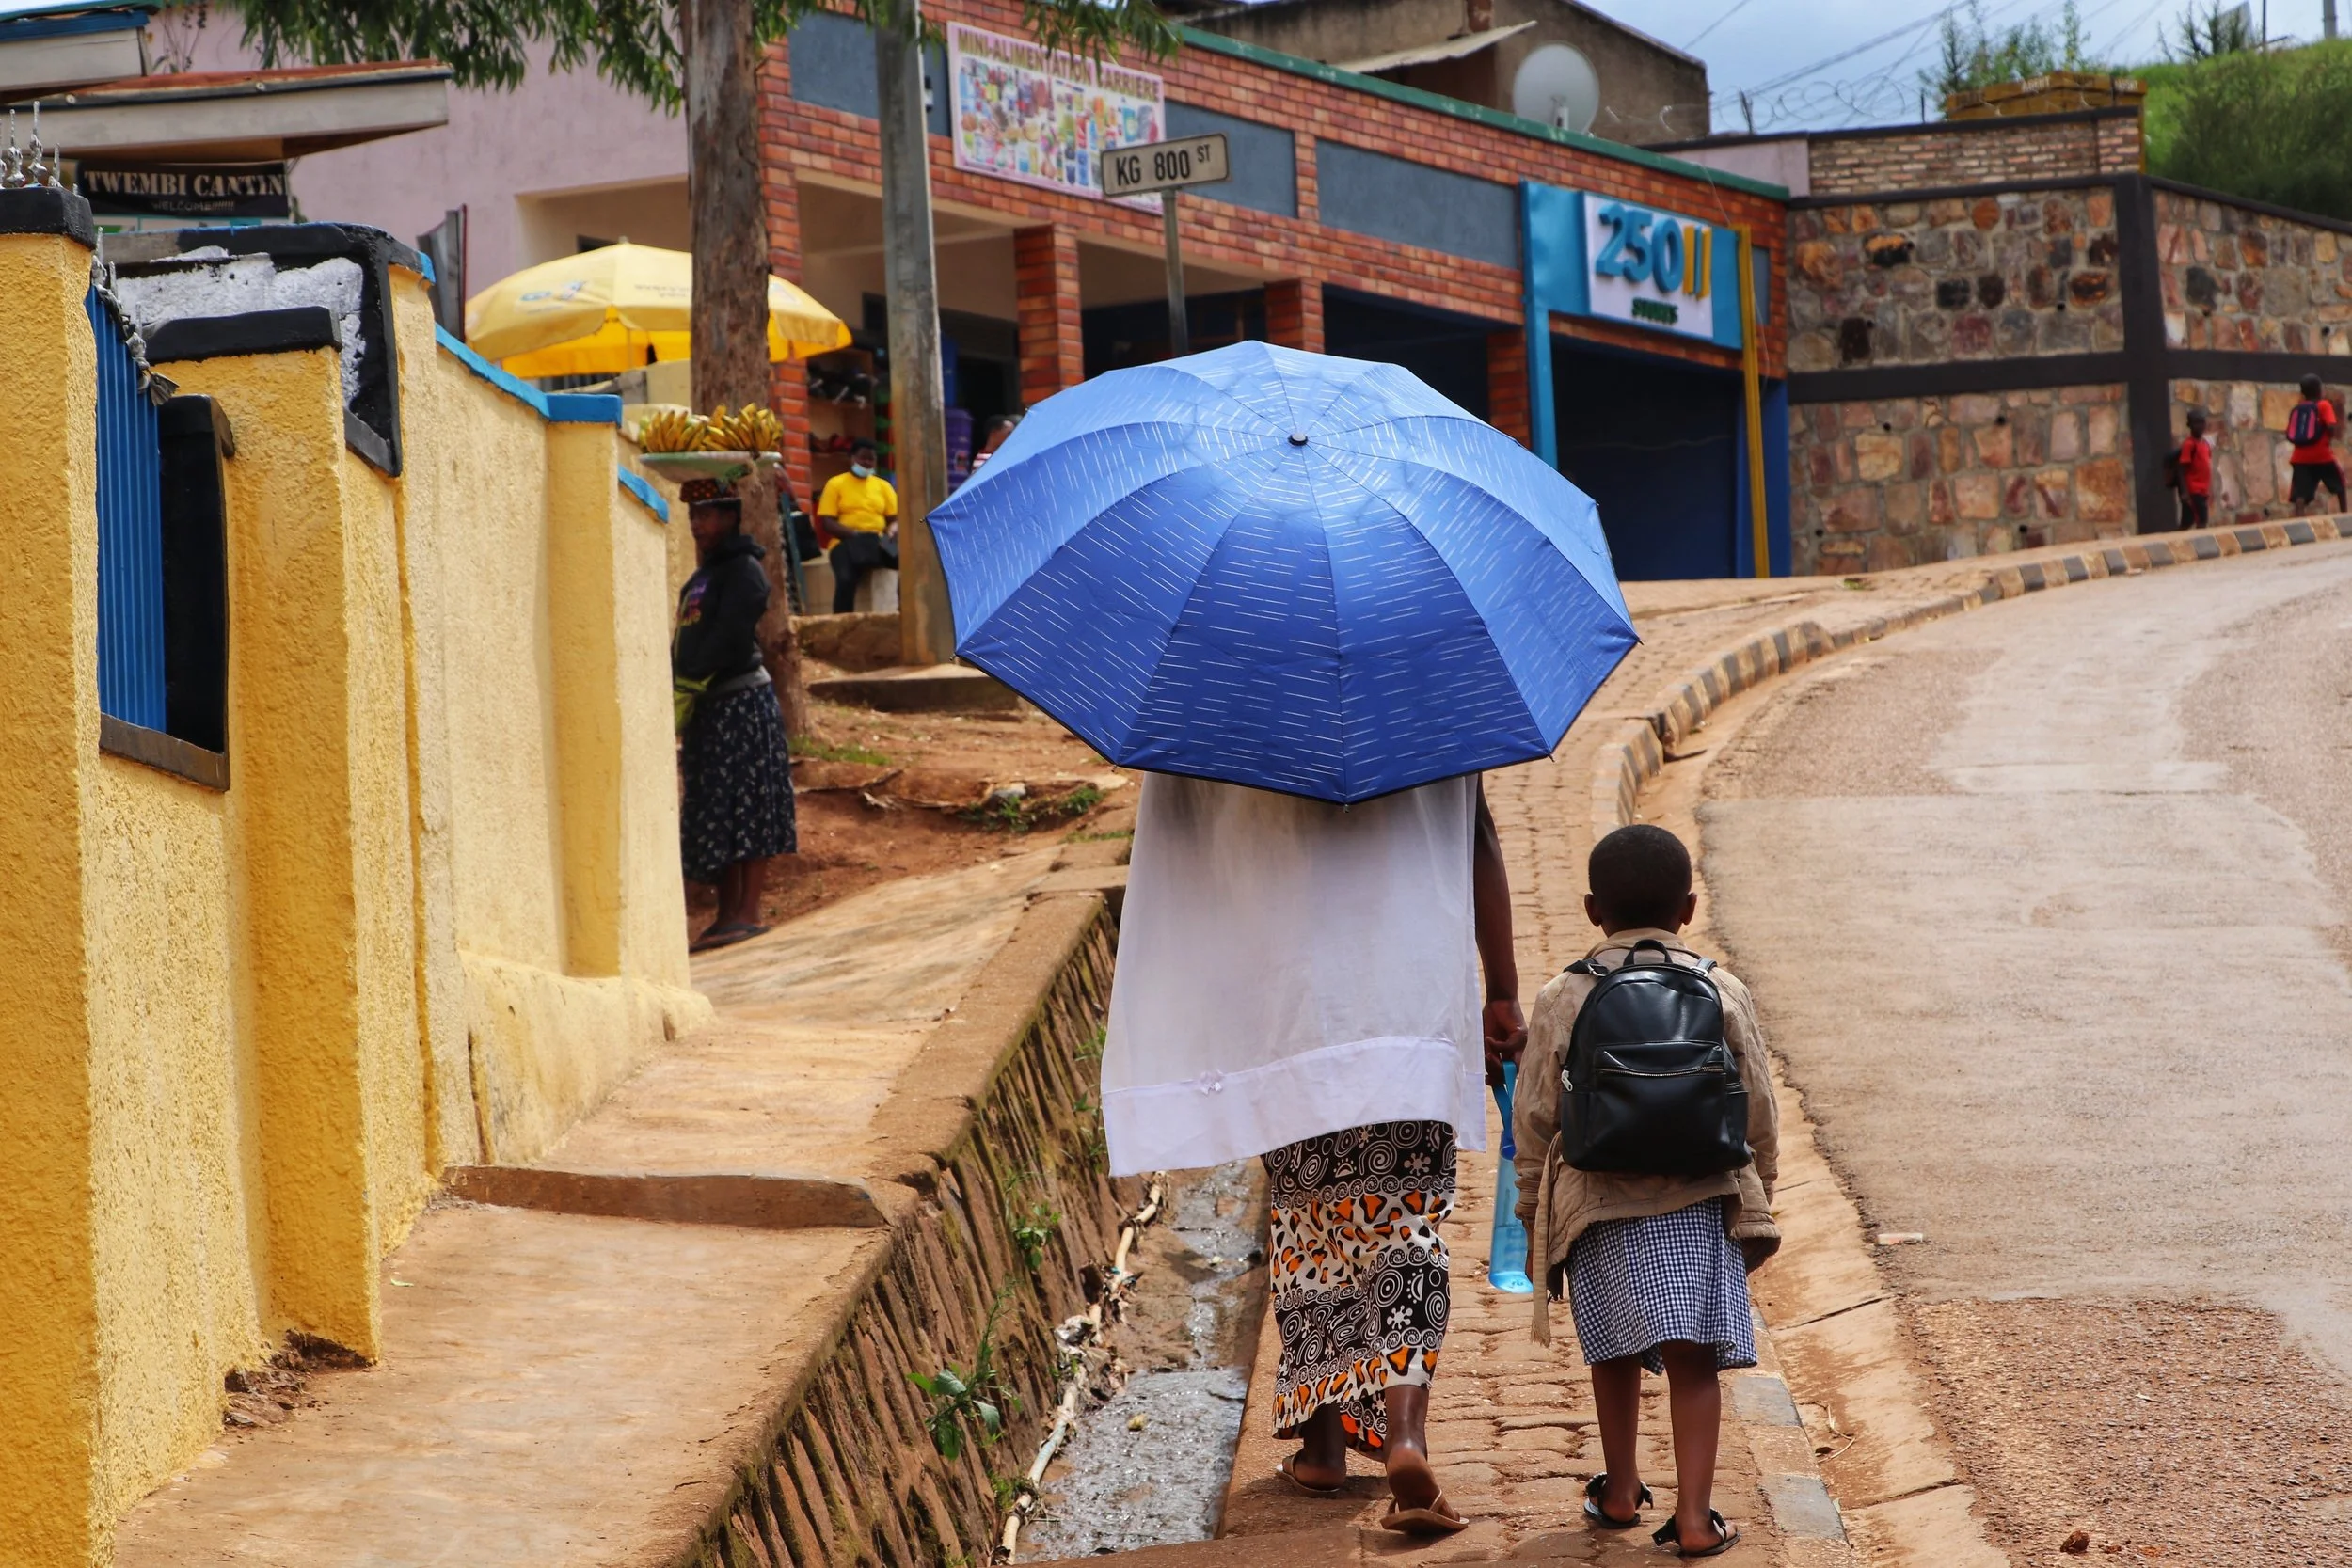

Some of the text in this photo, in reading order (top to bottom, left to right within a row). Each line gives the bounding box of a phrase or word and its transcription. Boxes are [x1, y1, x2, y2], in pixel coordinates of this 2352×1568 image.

[1097, 64, 1160, 103] ARRIERE
[84, 170, 186, 196] TWEMBI
[1116, 144, 1212, 186] KG 800 ST
